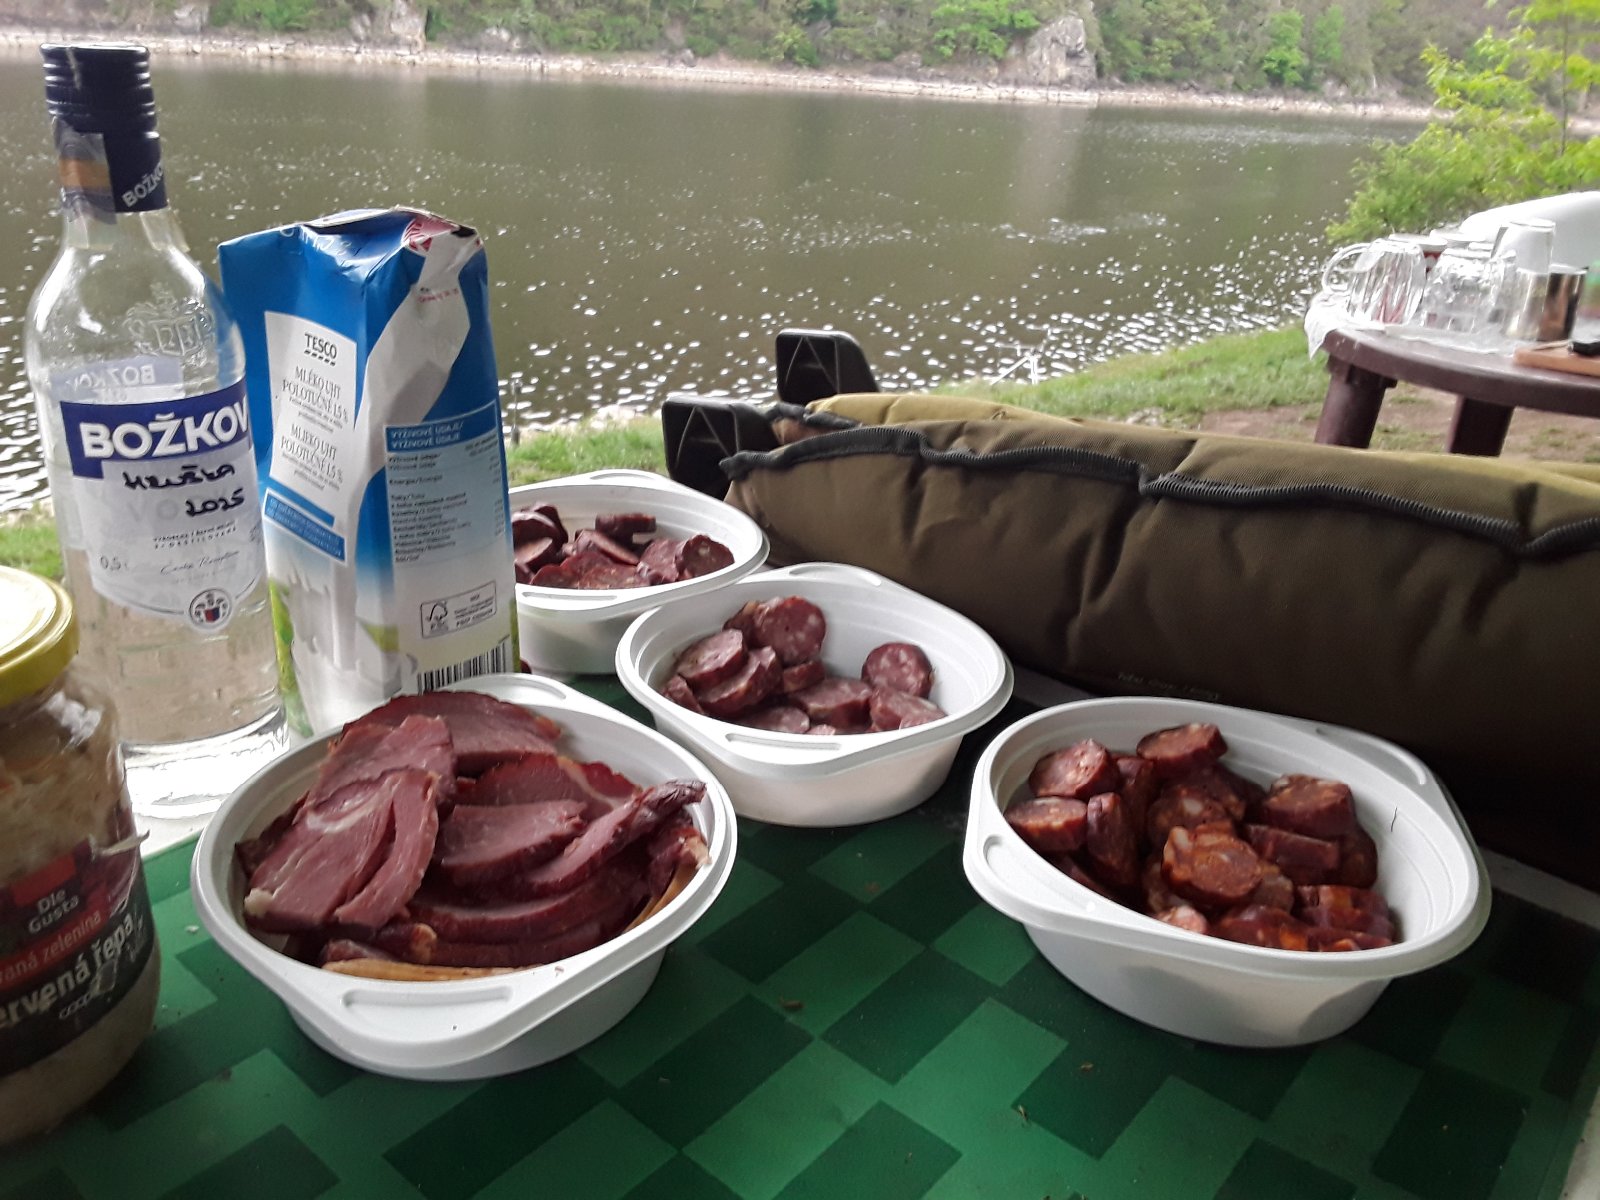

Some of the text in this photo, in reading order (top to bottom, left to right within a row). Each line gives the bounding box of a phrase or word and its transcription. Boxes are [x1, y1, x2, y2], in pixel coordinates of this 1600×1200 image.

[305, 333, 338, 360] TESCO
[295, 366, 324, 390] MLÉKO
[79, 394, 248, 459] BOŽKOV
[28, 895, 80, 934] Gusta
[43, 909, 102, 964] zelenina
